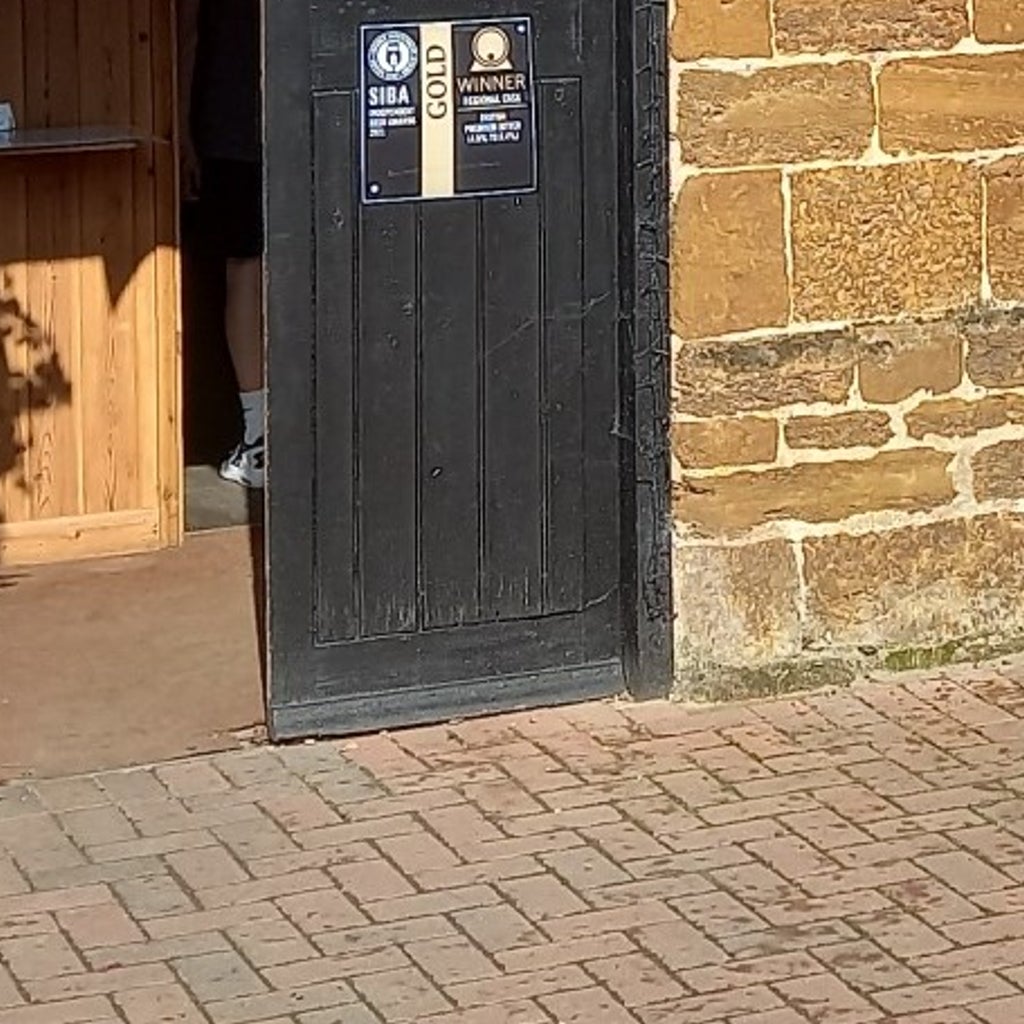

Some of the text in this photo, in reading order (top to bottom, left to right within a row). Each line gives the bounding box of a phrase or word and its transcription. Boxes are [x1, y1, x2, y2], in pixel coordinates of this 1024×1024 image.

[426, 44, 448, 120] GOLD
[457, 73, 527, 93] WINNER
[368, 85, 409, 106] SIBA
